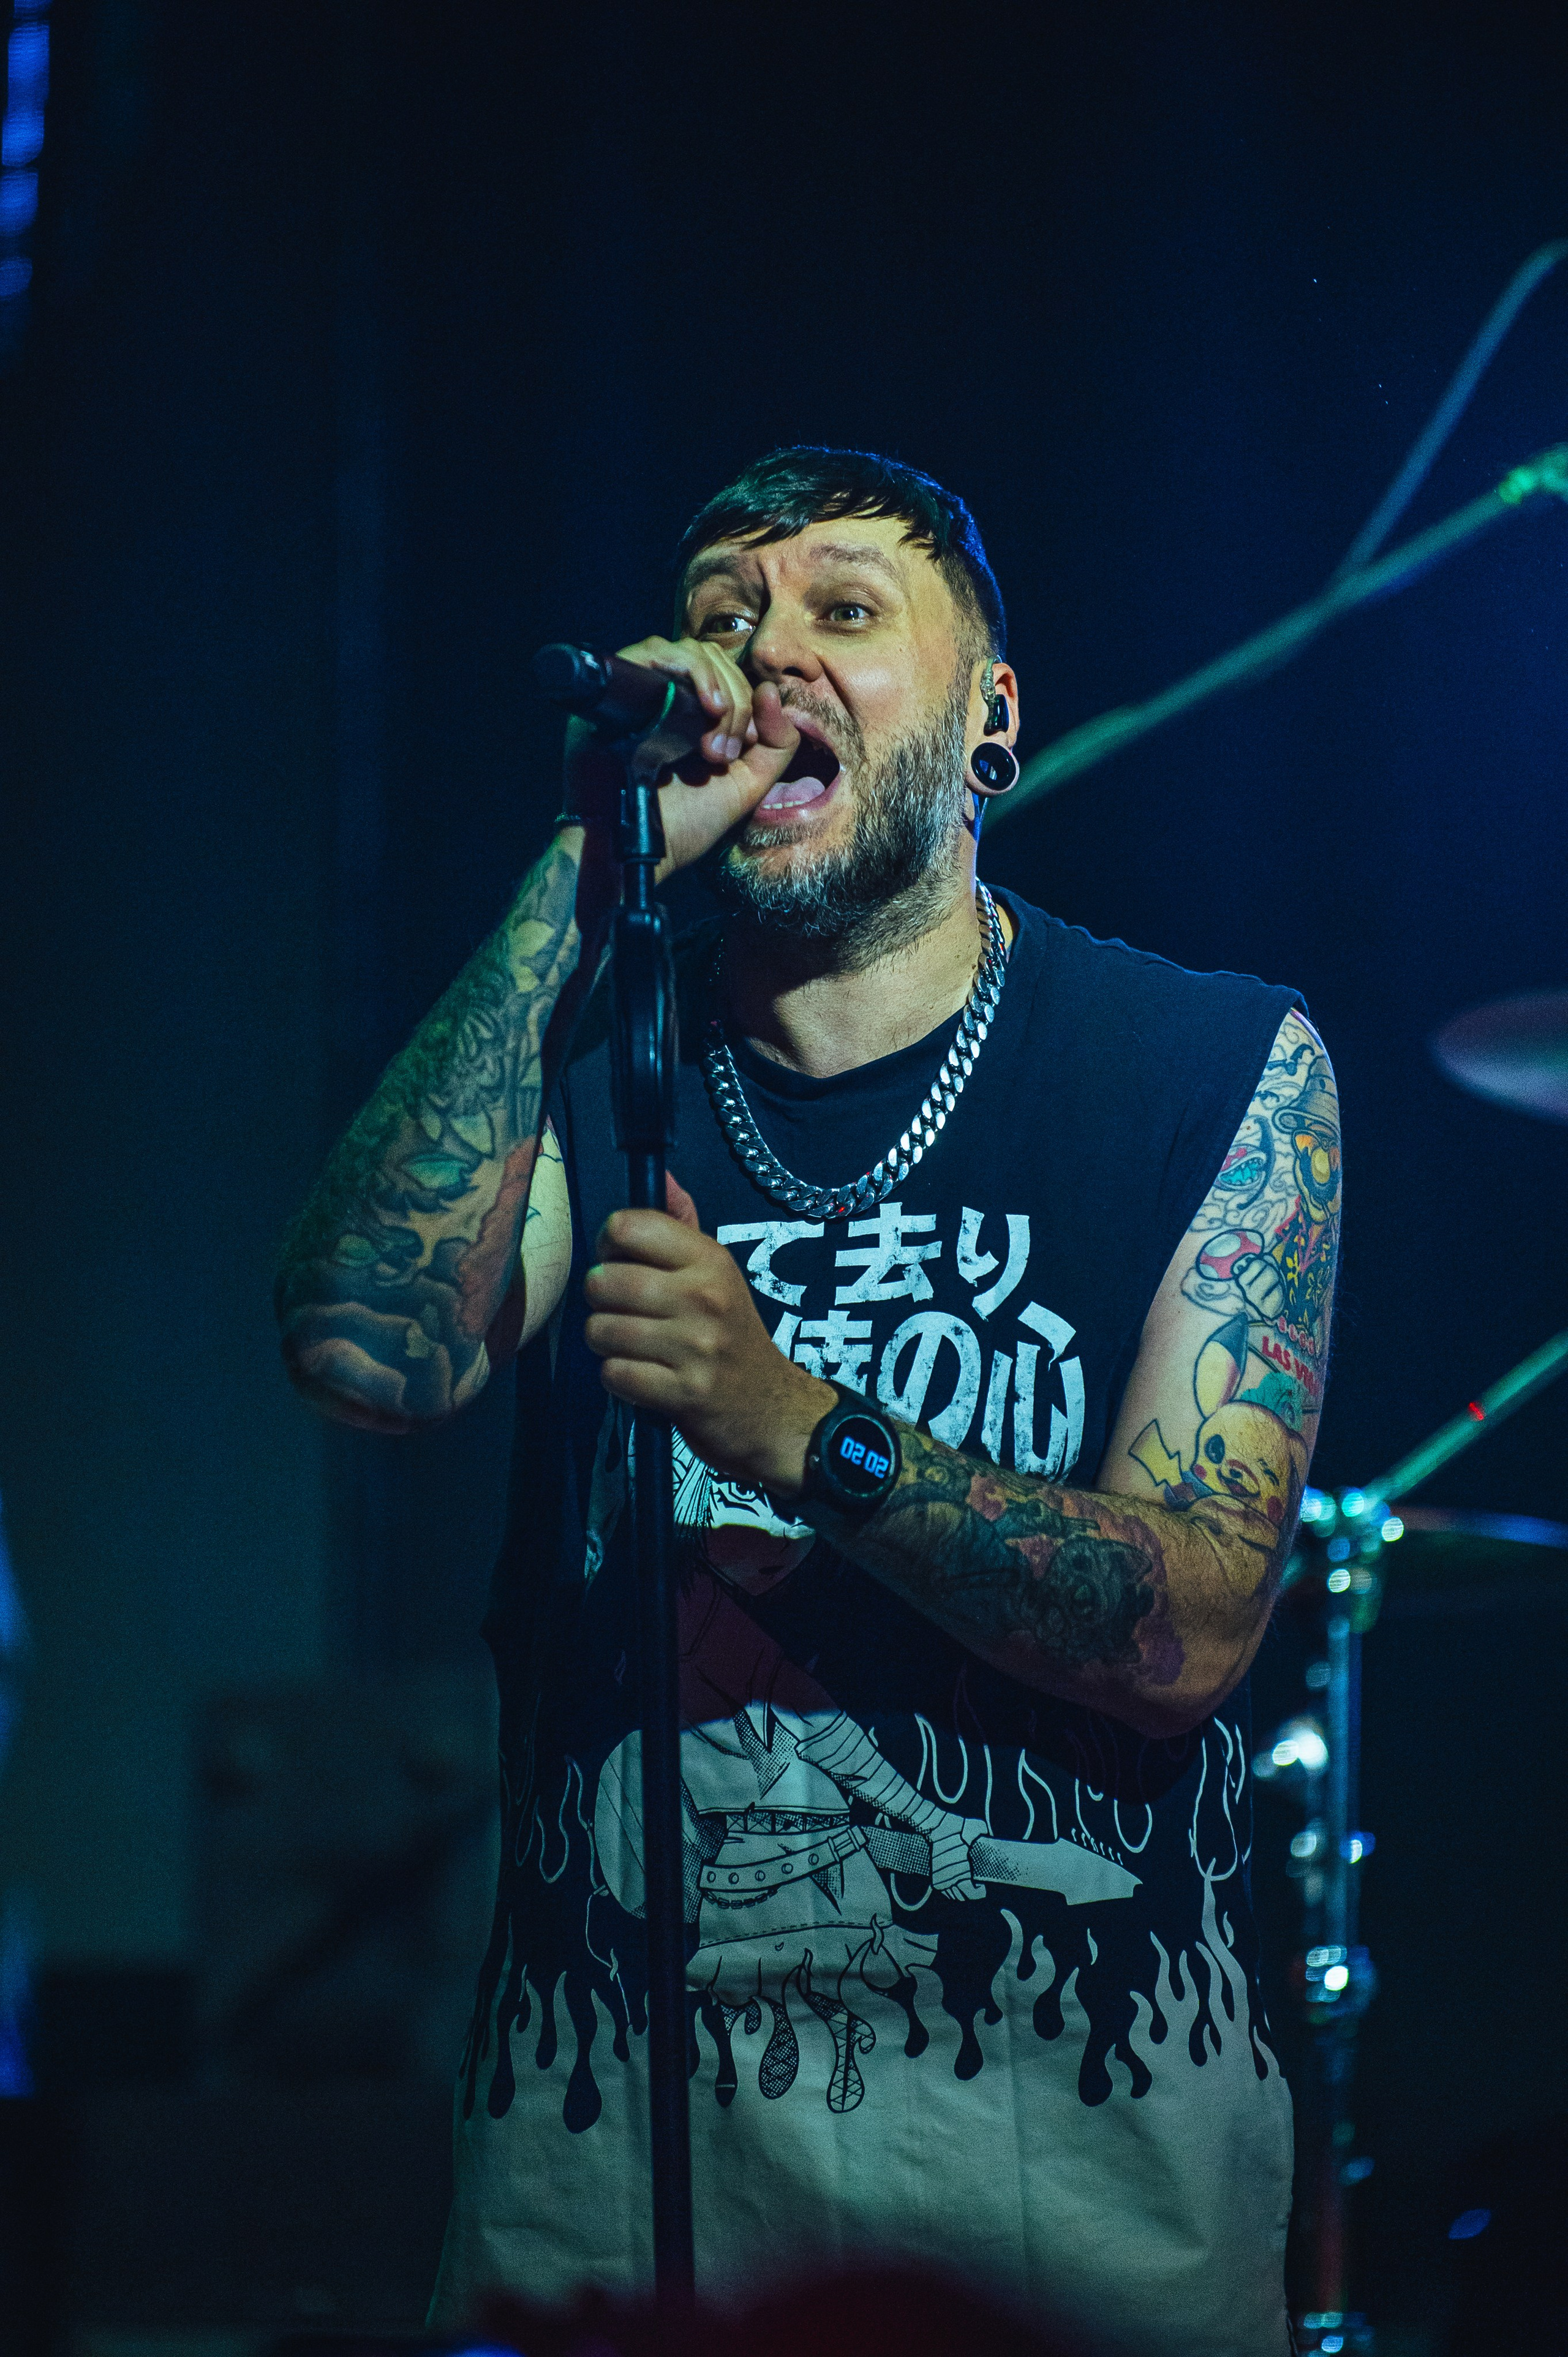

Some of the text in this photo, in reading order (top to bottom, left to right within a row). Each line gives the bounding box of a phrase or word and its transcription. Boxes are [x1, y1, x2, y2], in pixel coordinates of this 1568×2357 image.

[717, 1202, 1030, 1321] て去り
[1262, 1335, 1291, 1371] LAS
